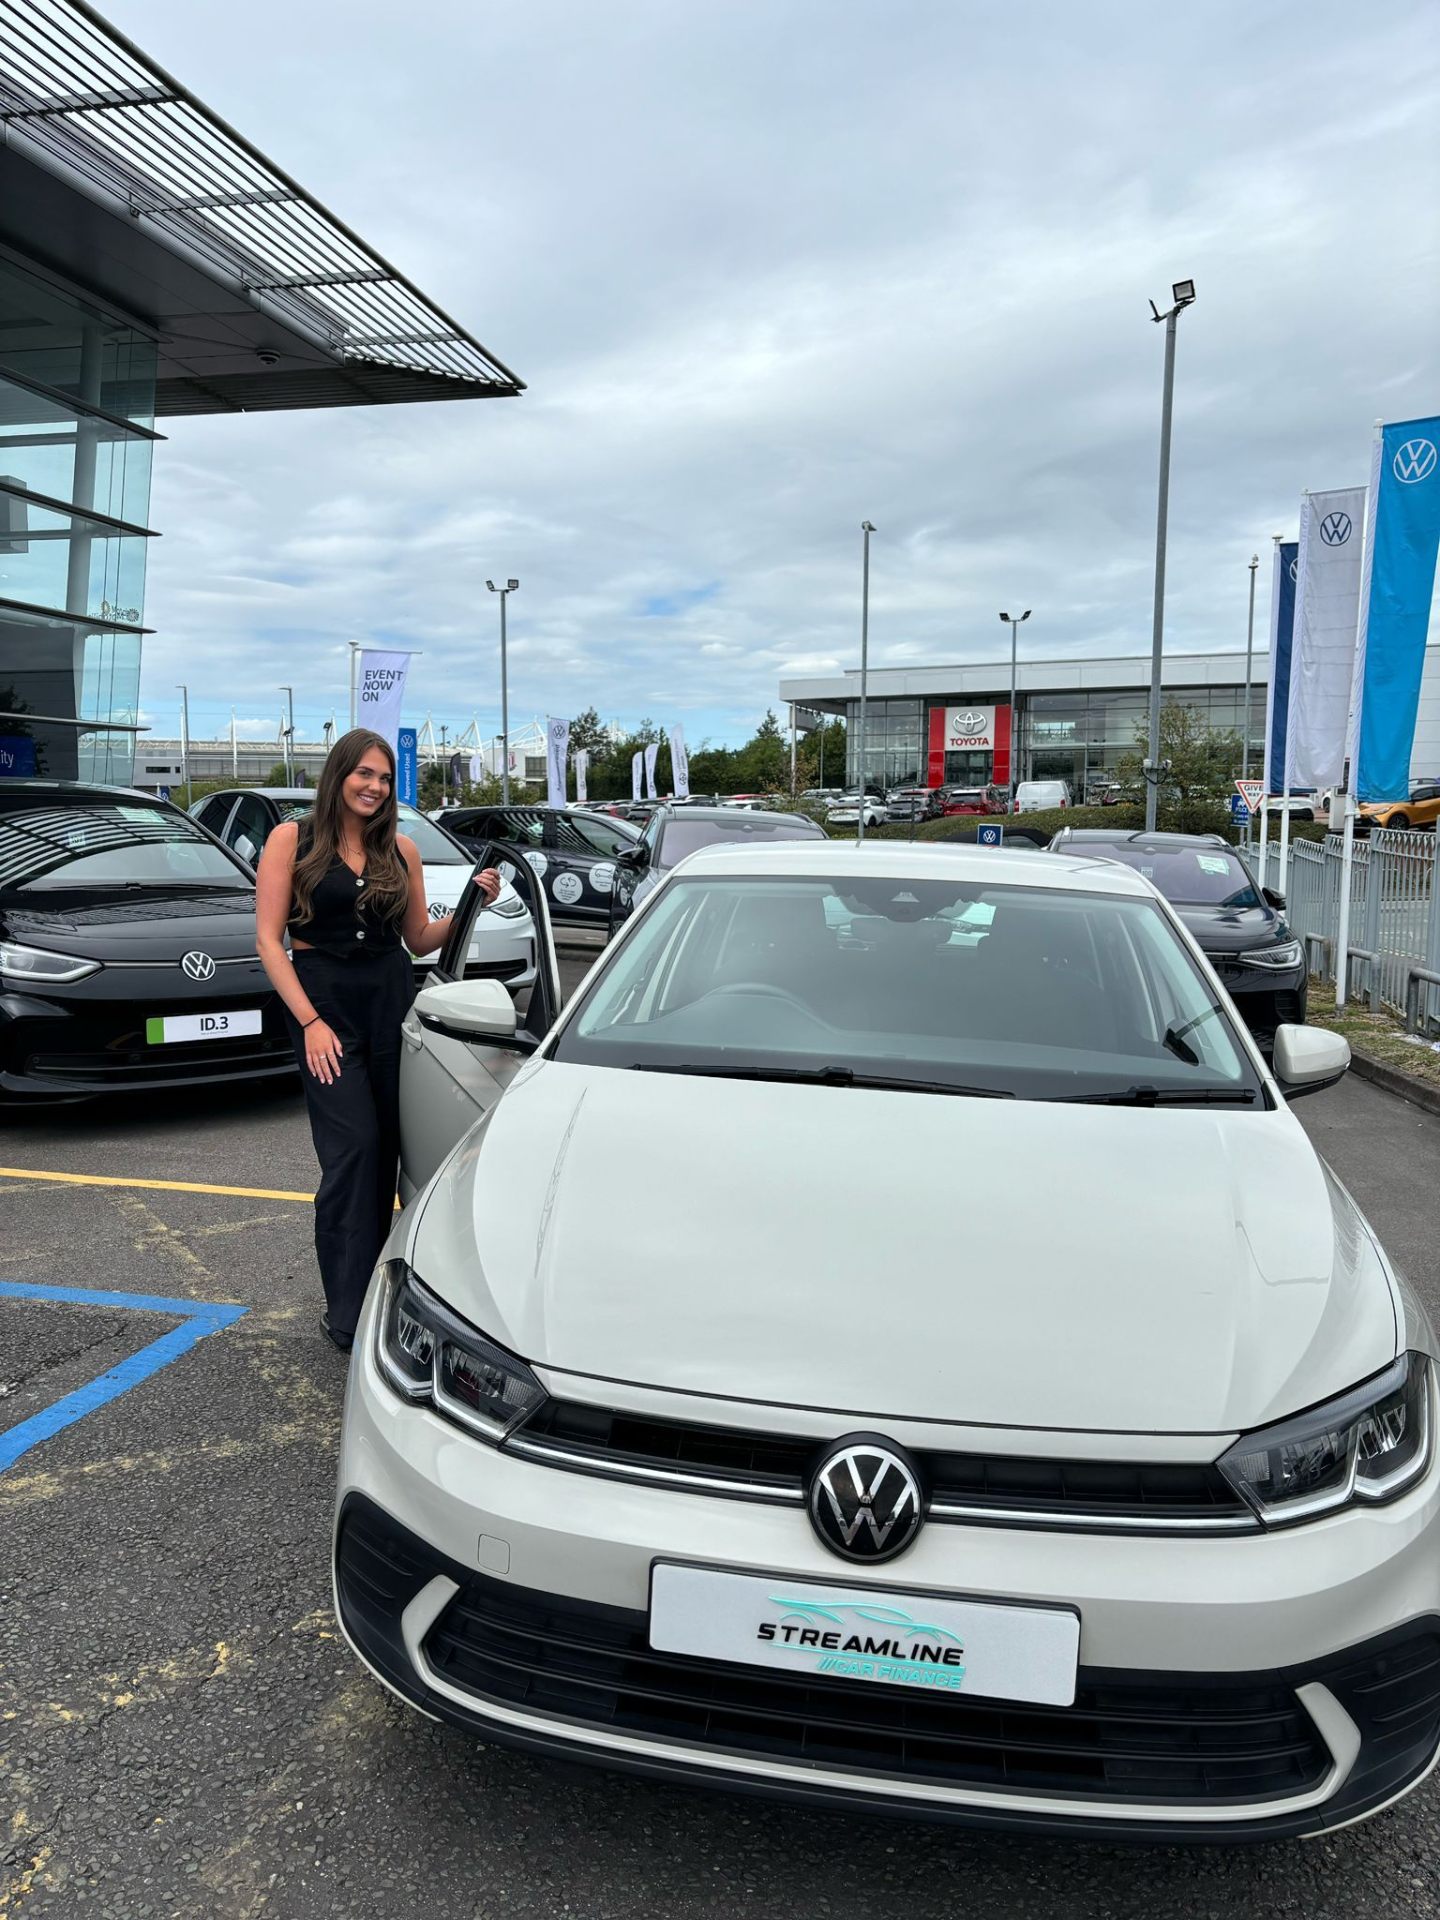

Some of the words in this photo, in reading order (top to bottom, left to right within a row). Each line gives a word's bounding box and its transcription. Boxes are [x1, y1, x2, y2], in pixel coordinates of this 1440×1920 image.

[365, 669, 403, 681] EVENT
[363, 680, 393, 690] NOW
[362, 691, 379, 702] ON
[949, 737, 990, 746] TOYOTA
[1244, 784, 1264, 792] GIVE
[200, 1016, 229, 1031] ID.3
[757, 1622, 964, 1666] STREAMLINE
[877, 1665, 962, 1689] FINANCE
